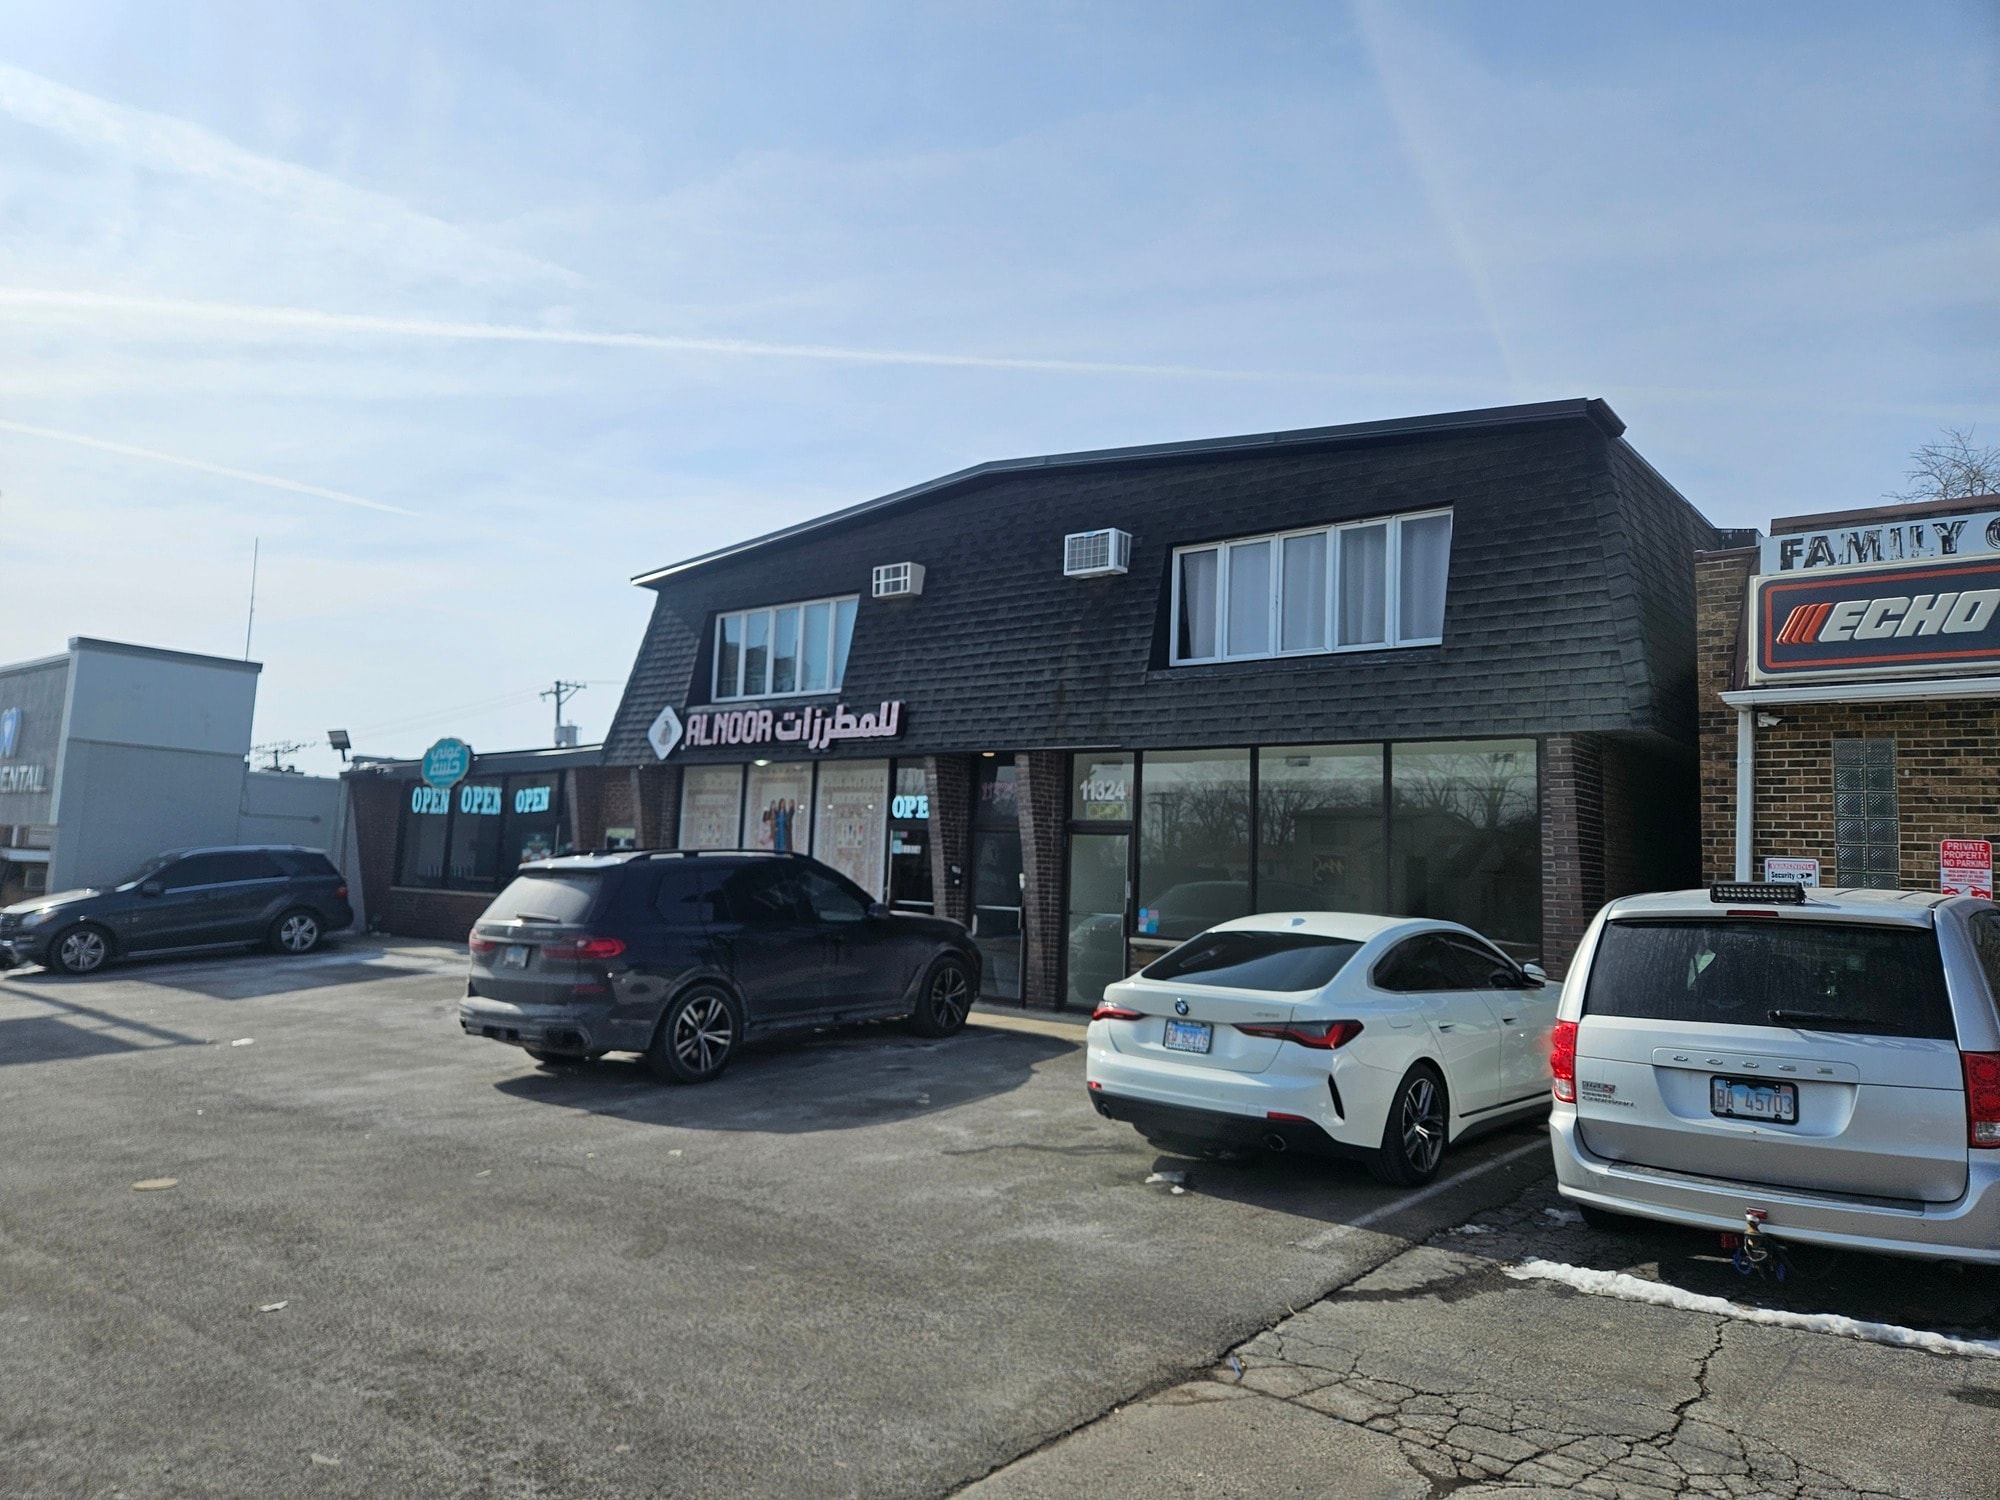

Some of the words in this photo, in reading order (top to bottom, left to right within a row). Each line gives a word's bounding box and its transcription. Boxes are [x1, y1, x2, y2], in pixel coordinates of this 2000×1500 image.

[1780, 520, 1968, 571] FAMILY
[1818, 588, 2000, 643] ECHO
[685, 709, 773, 746] ALNOOR
[775, 700, 900, 750] للمطرزات
[0, 765, 46, 793] ENTAL
[1080, 779, 1126, 801] 11324
[411, 786, 450, 814] OPEN
[461, 785, 502, 815] OPEN
[515, 786, 550, 813] OPEN
[892, 795, 929, 819] OPE
[1943, 850, 1989, 860] PROPERTY
[1947, 842, 1985, 851] PRIVATE
[1771, 871, 1795, 880] Security
[1943, 859, 1955, 867] NO
[1956, 860, 1990, 868] PARKING
[1716, 1088, 1734, 1109] BA
[1745, 1091, 1793, 1115] 45703
